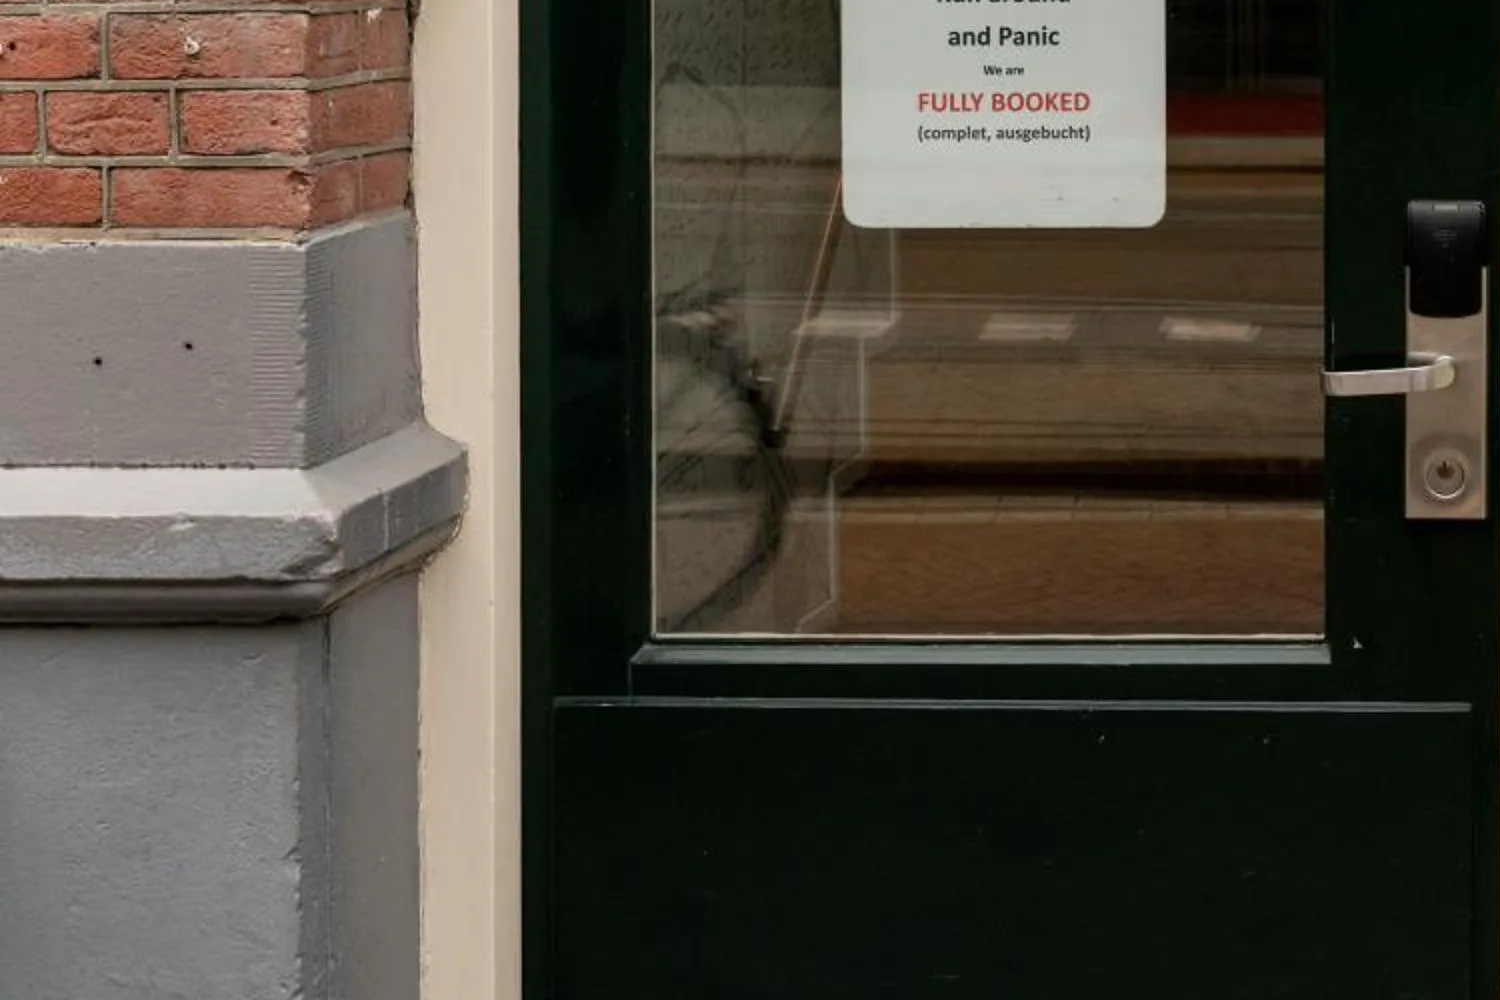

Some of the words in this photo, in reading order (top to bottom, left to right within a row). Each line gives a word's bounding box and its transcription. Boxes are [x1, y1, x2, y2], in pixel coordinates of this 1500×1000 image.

[948, 26, 991, 47] and
[998, 26, 1060, 47] Panic
[983, 65, 1002, 77] We
[1005, 66, 1025, 77] are
[917, 91, 984, 113] FULLY
[991, 91, 1091, 113] BOOKED
[917, 125, 992, 143] (complet,
[995, 125, 1091, 143] ausgebucht)
